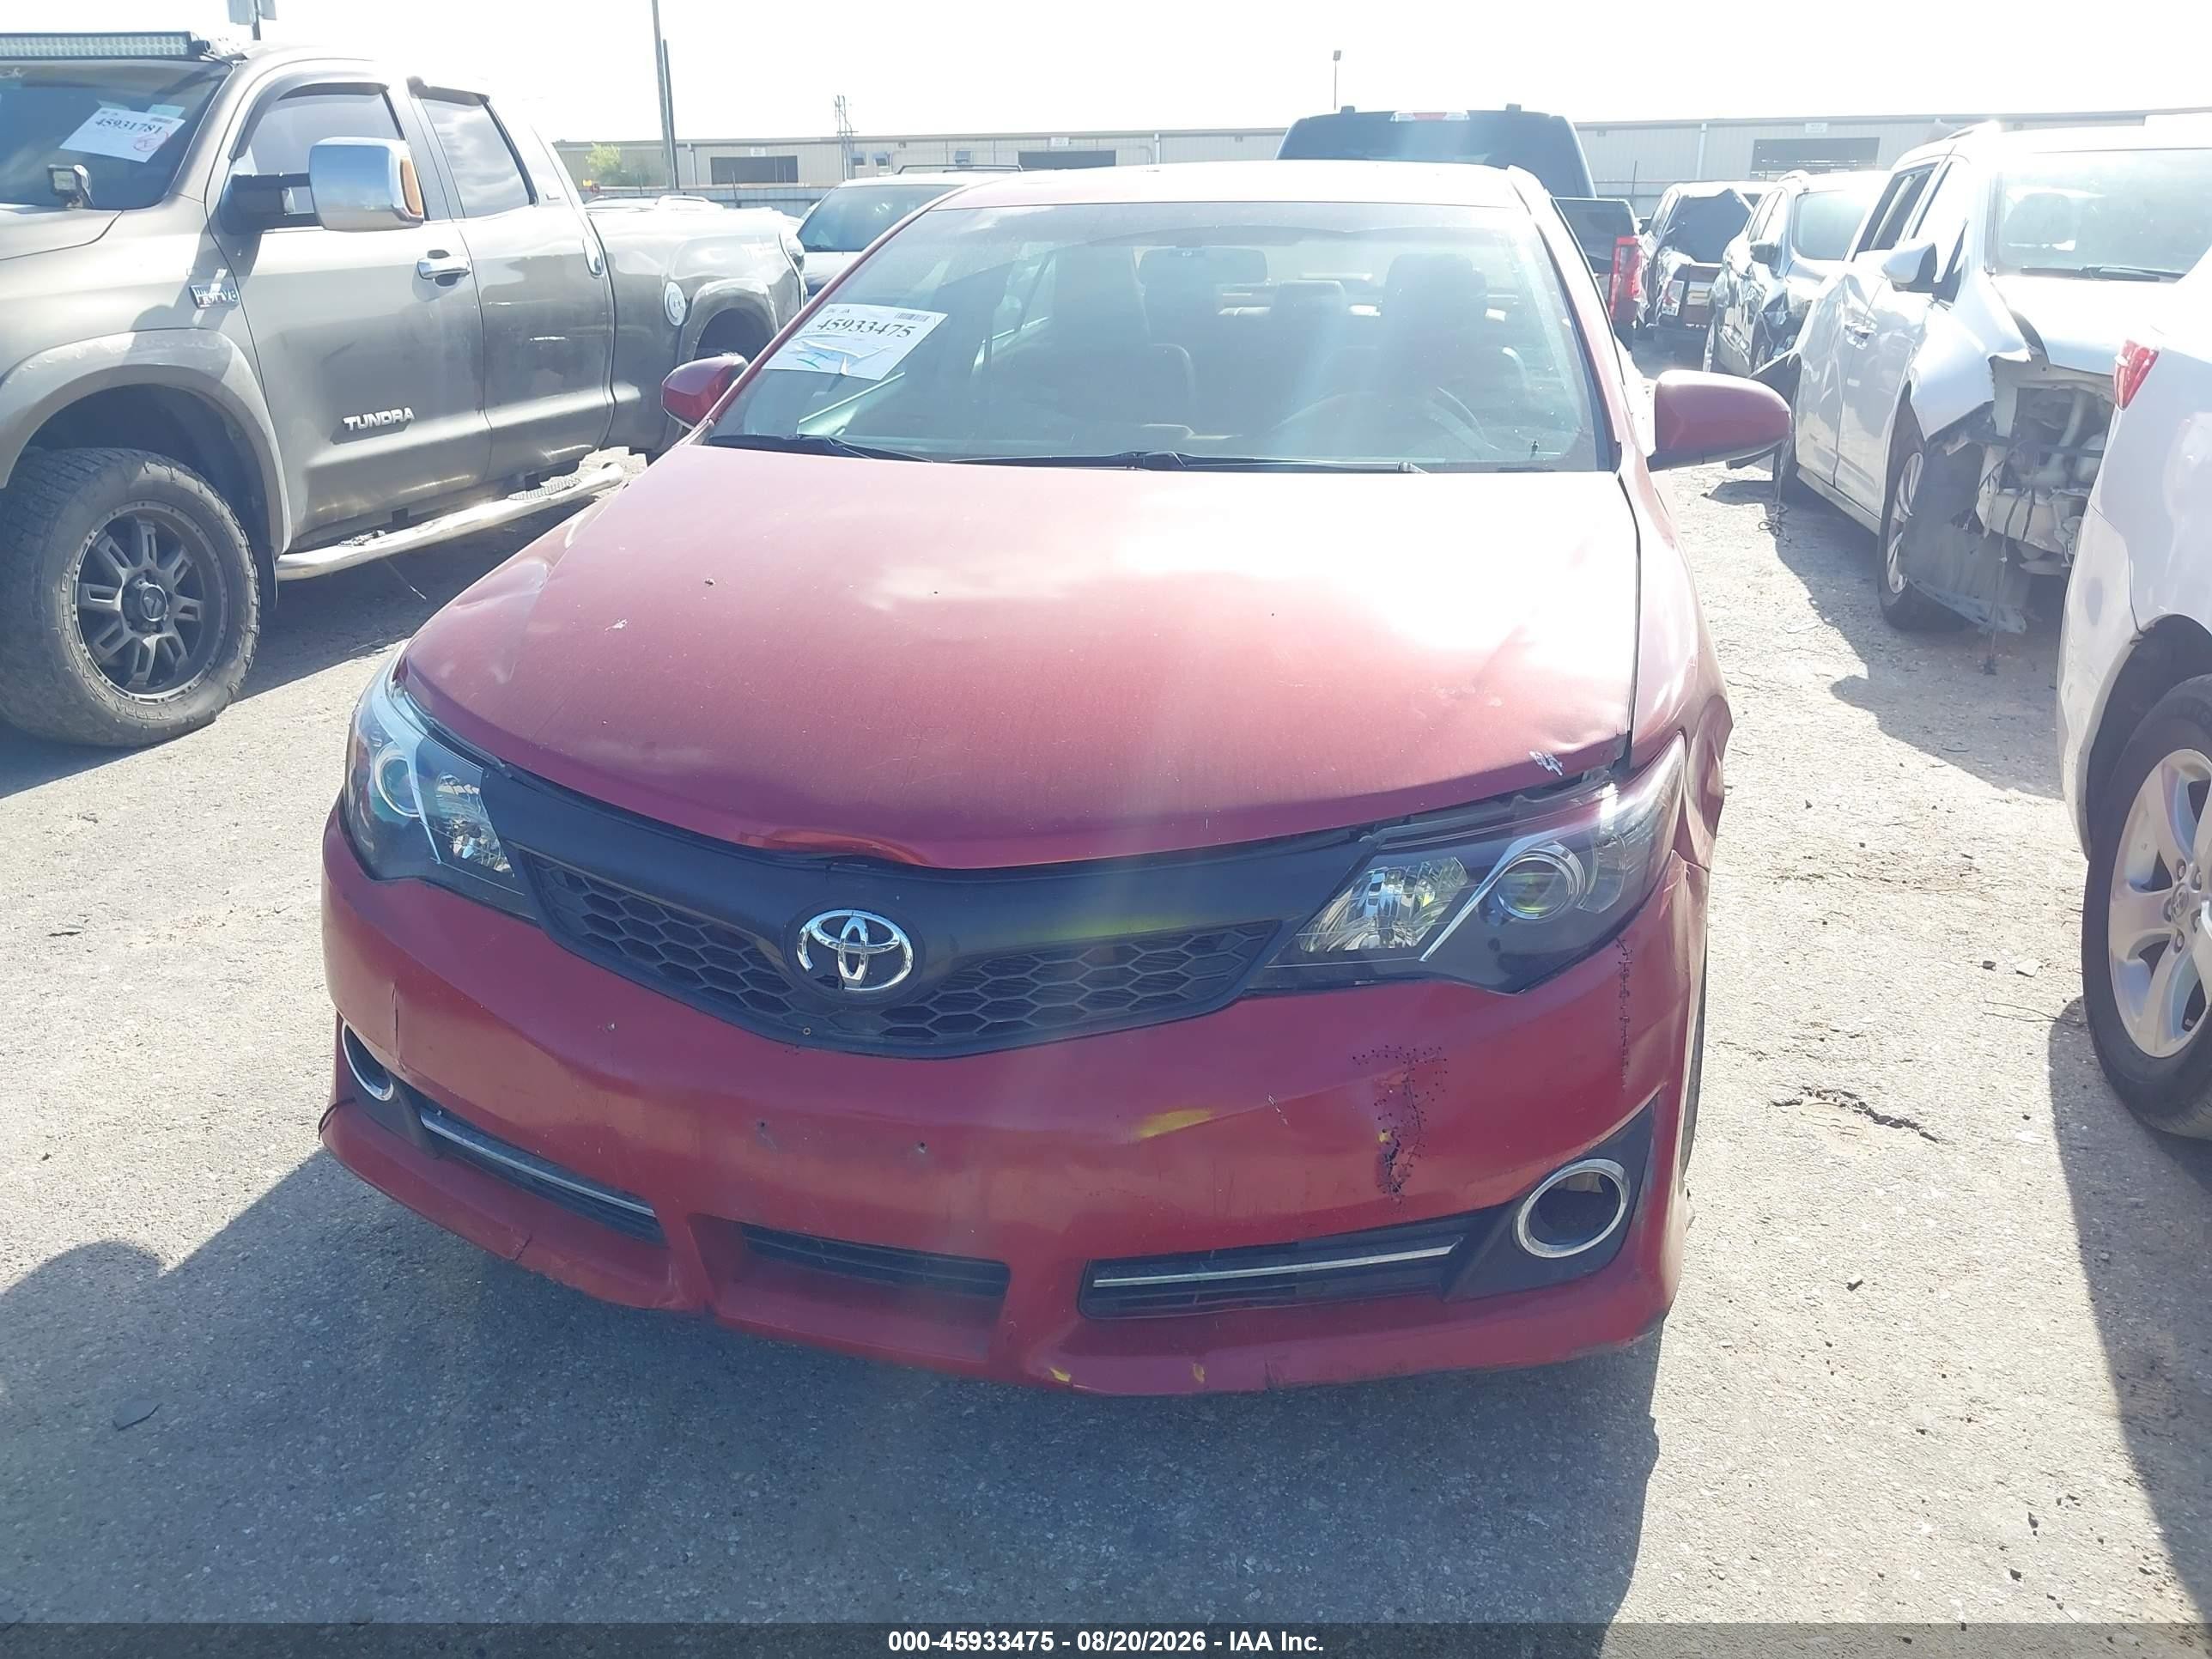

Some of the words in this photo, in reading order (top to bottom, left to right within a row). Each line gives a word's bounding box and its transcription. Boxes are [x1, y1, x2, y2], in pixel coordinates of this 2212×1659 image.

[95, 118, 162, 135] 45931781
[817, 317, 917, 338] 45933475
[343, 407, 415, 431] TUNDRA
